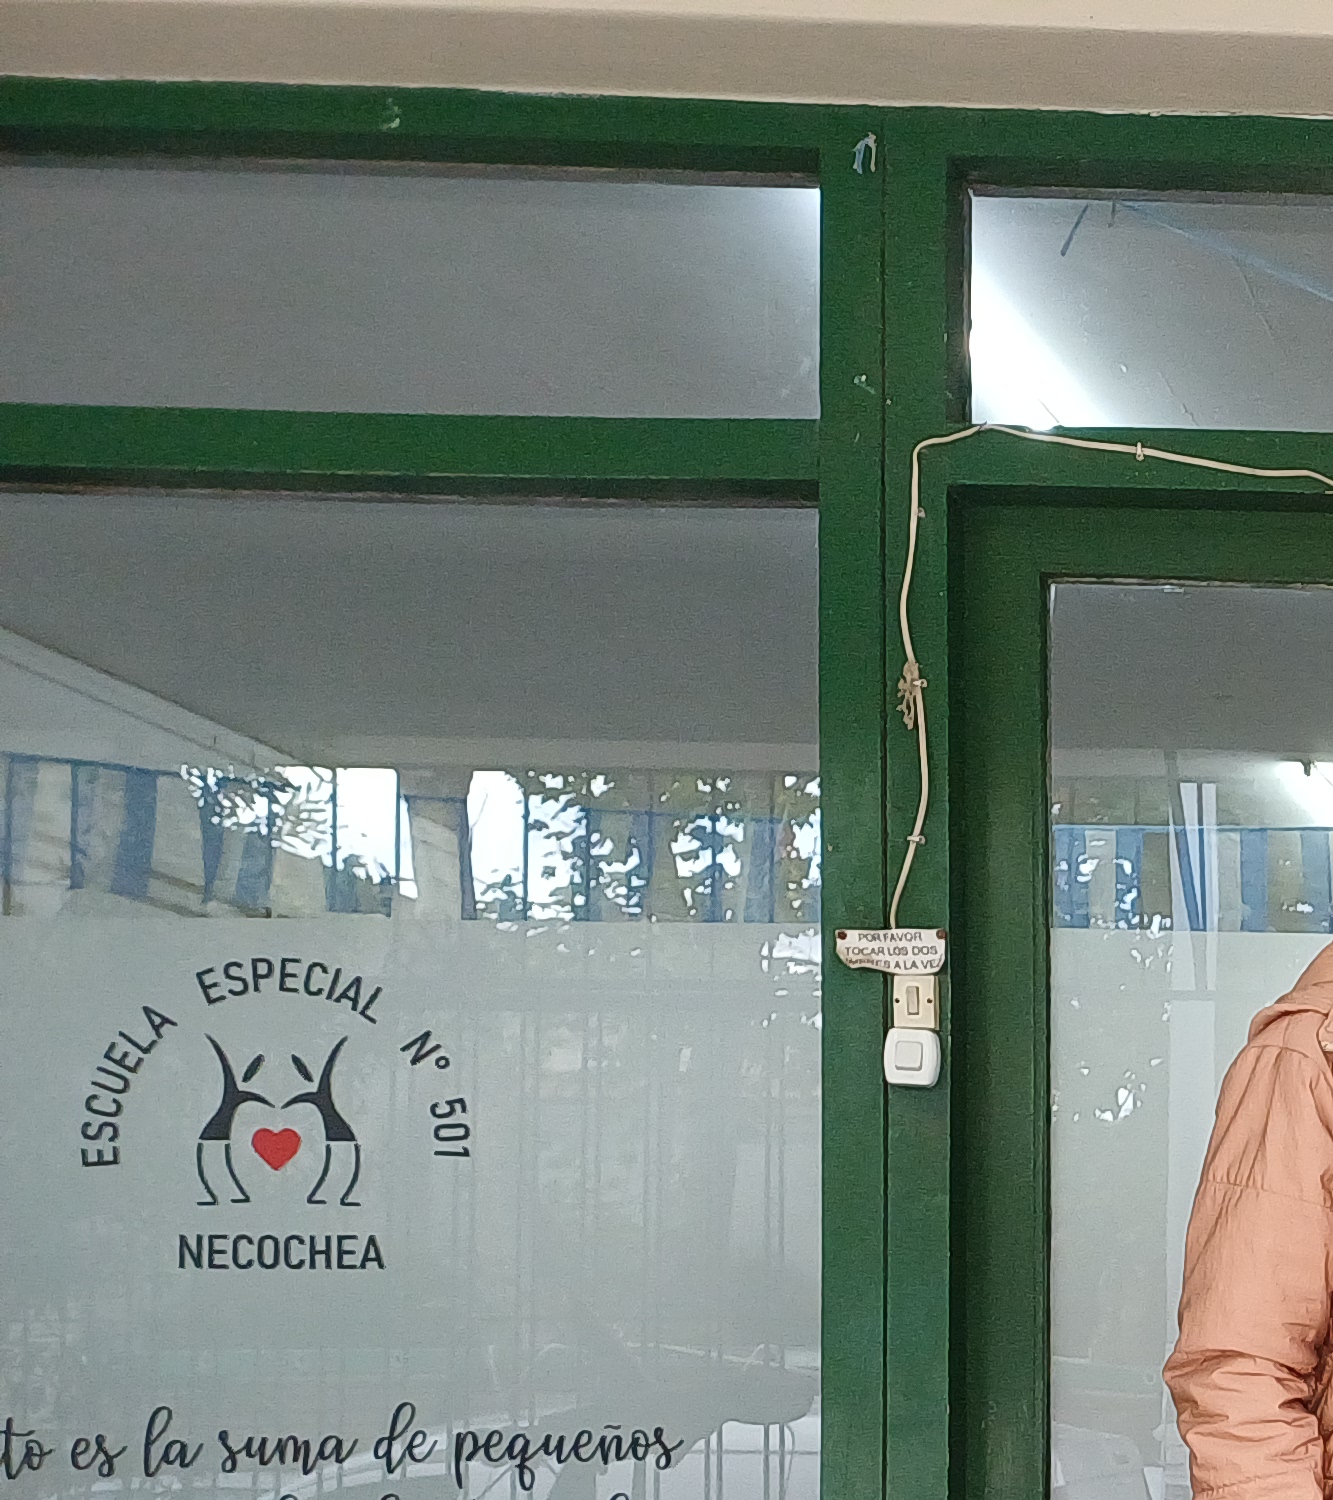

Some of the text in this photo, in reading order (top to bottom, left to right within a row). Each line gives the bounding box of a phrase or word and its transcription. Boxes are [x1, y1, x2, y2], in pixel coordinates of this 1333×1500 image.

[883, 931, 922, 942] FAVOR
[845, 946, 885, 956] TOCAR
[911, 945, 938, 956] DOS
[893, 959, 901, 970] A
[80, 1004, 178, 1168] ESCUELA
[195, 957, 385, 1024] ESPECIAL
[429, 1096, 471, 1159] 501
[178, 1234, 385, 1270] NECOCHEA
[0, 1402, 684, 1490] to es la suma de pequeños
